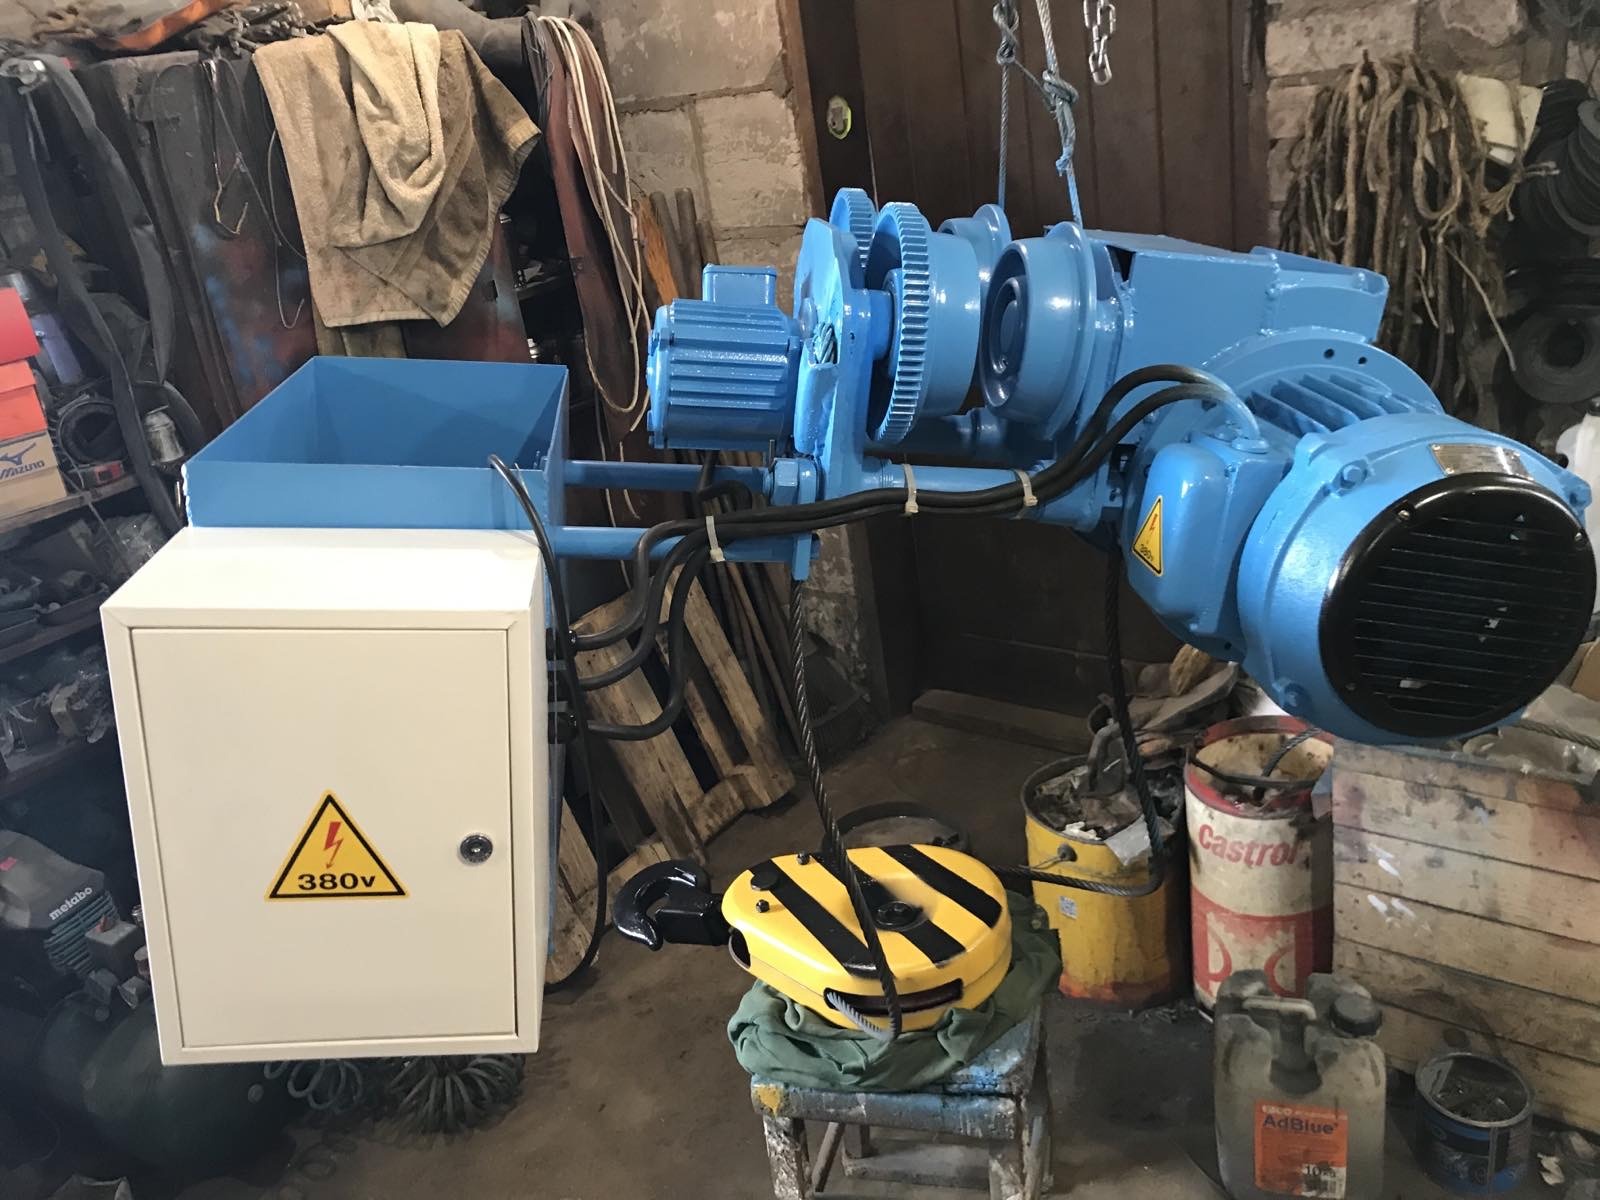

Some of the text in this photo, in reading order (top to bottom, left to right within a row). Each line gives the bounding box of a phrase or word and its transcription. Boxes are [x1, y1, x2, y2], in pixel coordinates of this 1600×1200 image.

[0, 460, 45, 480] MIZUNO
[1199, 824, 1298, 868] Castrol
[298, 873, 375, 890] 380v
[49, 887, 92, 920] metabo
